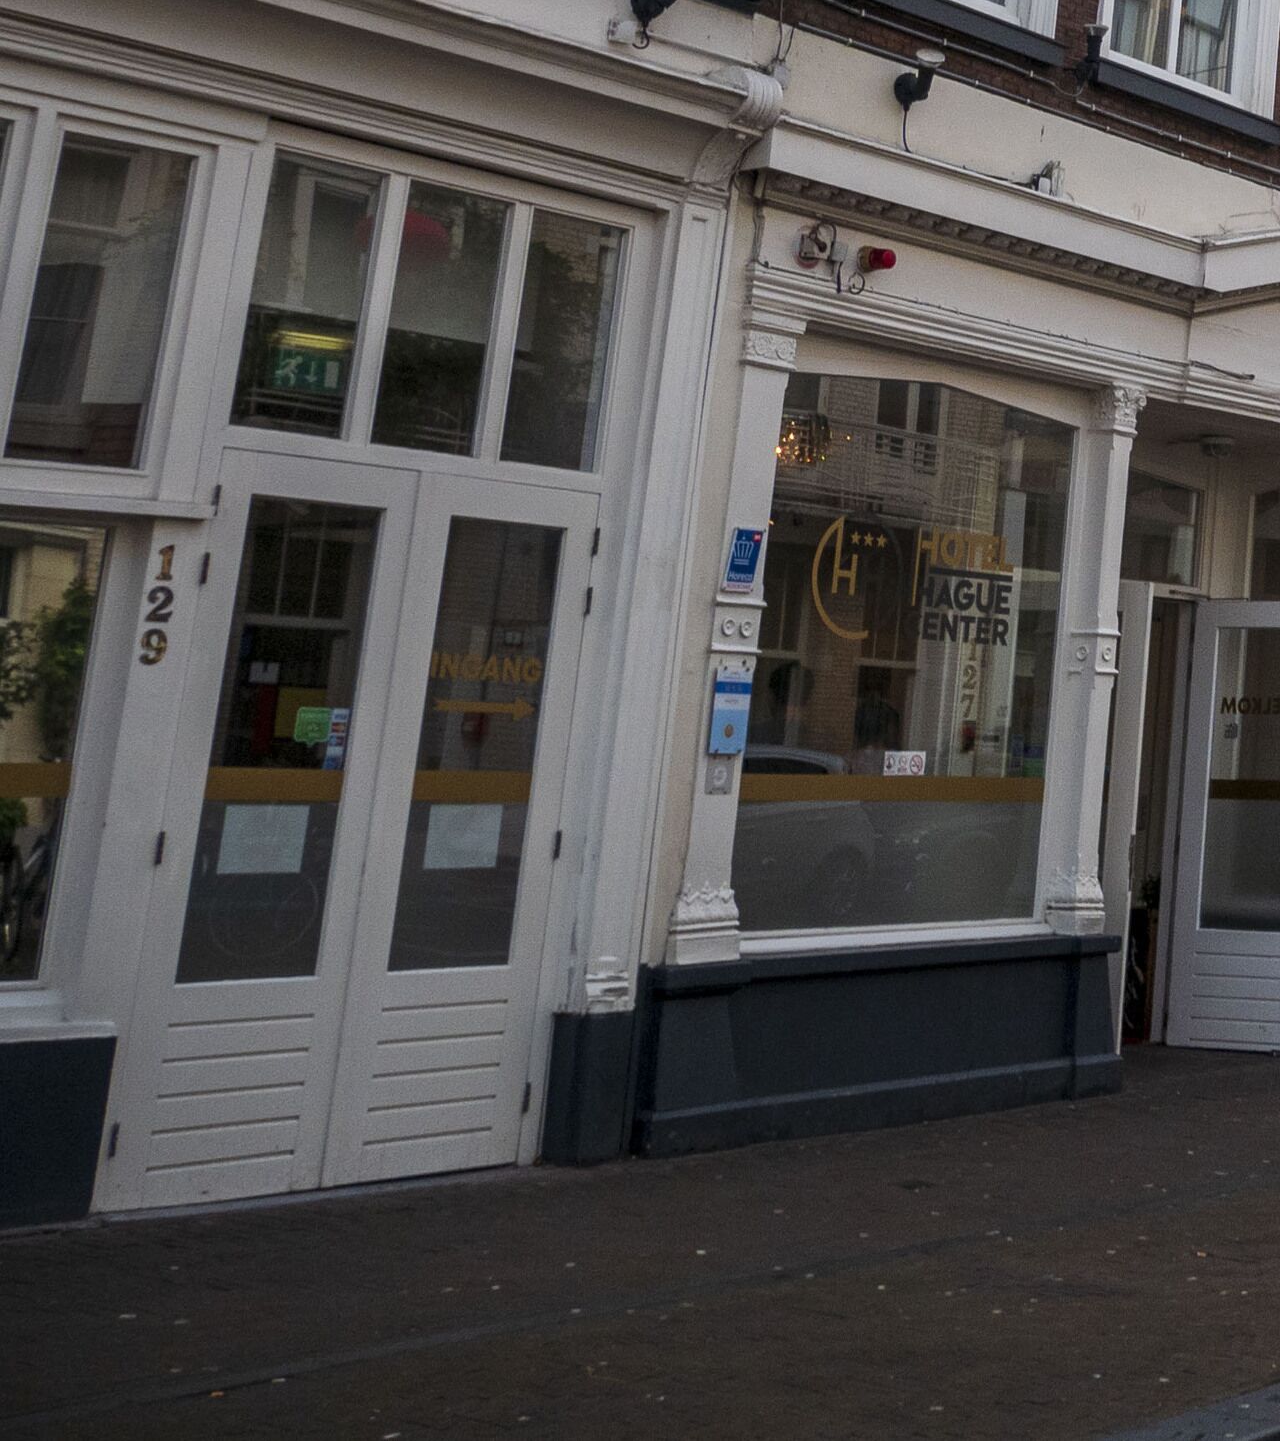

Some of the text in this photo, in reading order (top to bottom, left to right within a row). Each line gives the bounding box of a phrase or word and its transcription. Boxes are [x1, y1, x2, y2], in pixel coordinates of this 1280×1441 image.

[917, 526, 1014, 573] HOTEL
[139, 544, 176, 666] 129
[920, 612, 1010, 646] ENTER
[429, 653, 546, 684] INGANG
